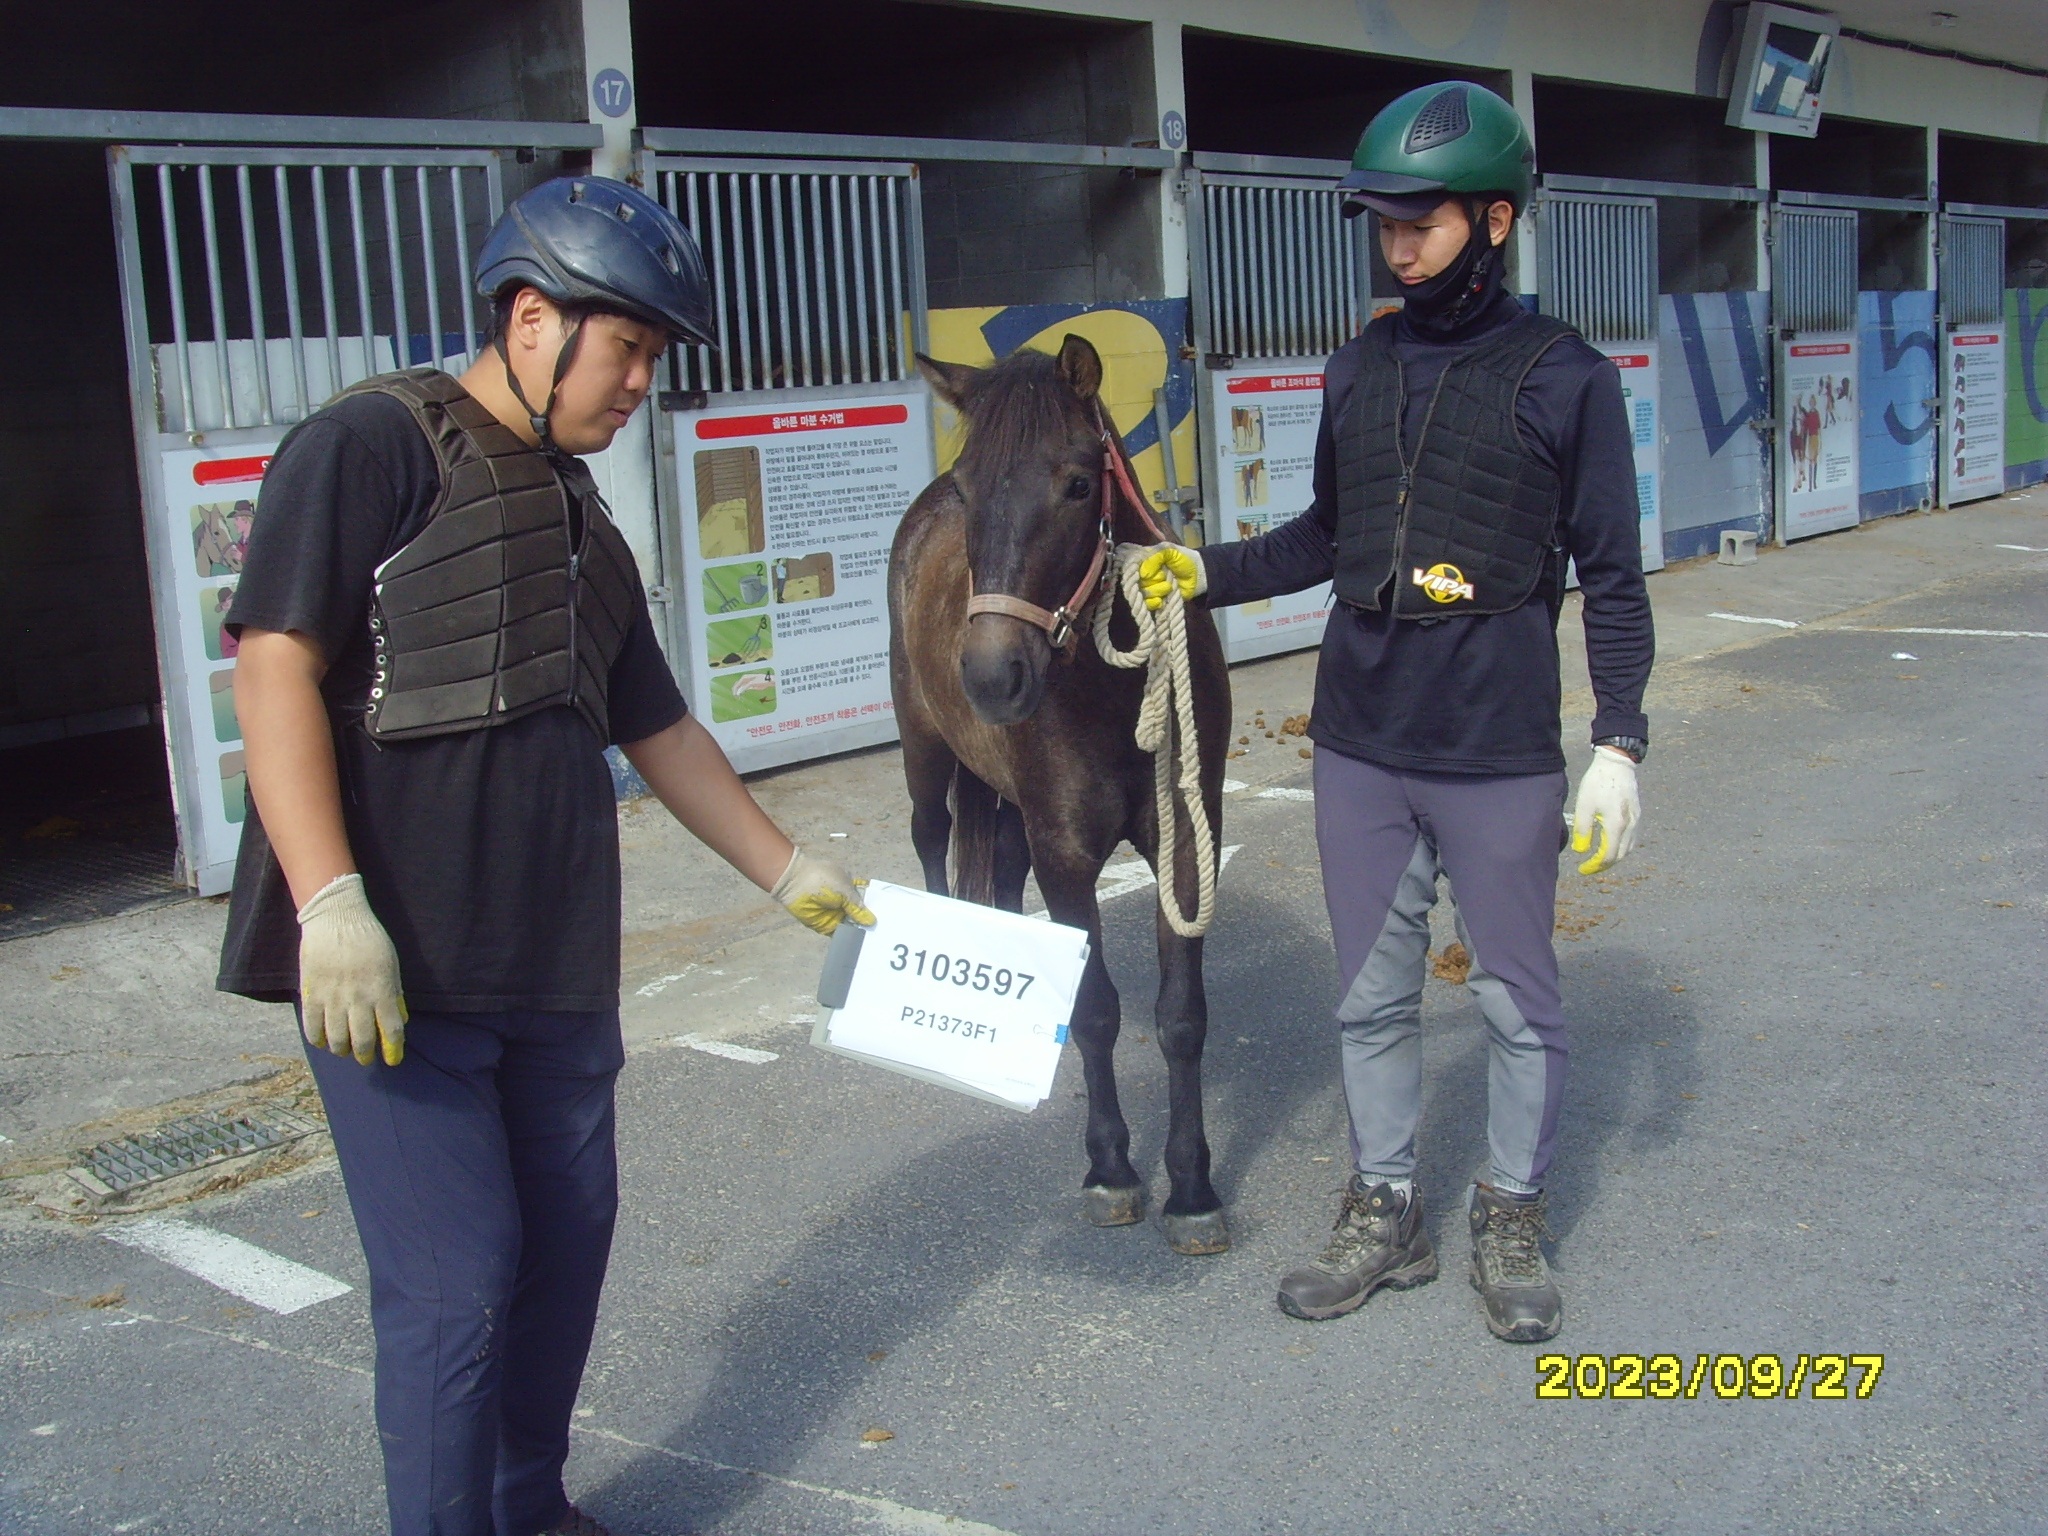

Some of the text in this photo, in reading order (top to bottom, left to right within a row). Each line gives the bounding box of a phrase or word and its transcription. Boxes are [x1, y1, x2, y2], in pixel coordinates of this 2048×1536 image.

[601, 79, 625, 106] 17
[1166, 119, 1182, 141] 18
[772, 412, 844, 429] 올바른 마분 수거법
[756, 563, 764, 576] 2
[1412, 567, 1475, 600] VIPA
[760, 617, 768, 629] 3
[764, 670, 772, 682] 4
[805, 712, 835, 726] 안전조끼
[837, 706, 858, 720] 착용은
[860, 702, 881, 715] 선택이
[889, 943, 1035, 1000] 3103597
[900, 1006, 997, 1043] P21373F1
